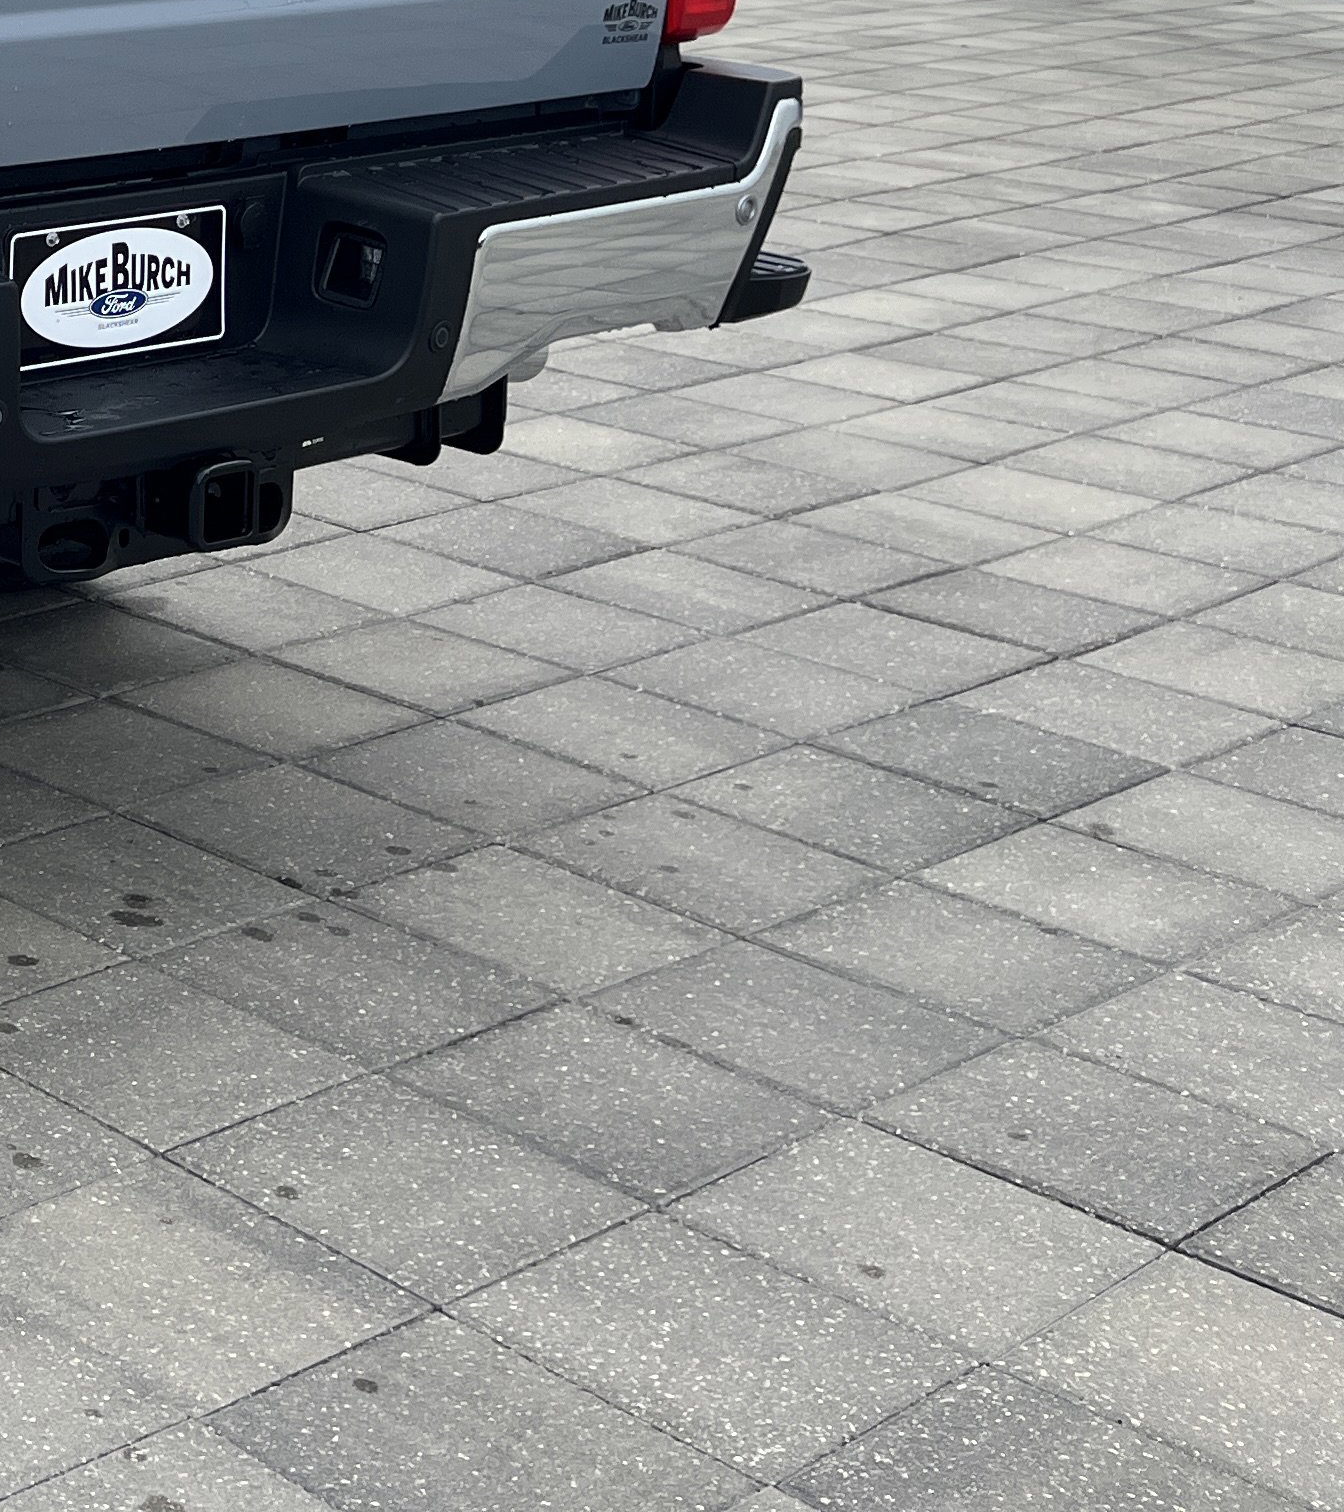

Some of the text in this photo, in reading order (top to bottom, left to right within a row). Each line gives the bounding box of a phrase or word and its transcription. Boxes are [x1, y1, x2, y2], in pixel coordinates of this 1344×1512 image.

[45, 242, 190, 306] MIKE BURCH
[101, 294, 136, 315] Ford
